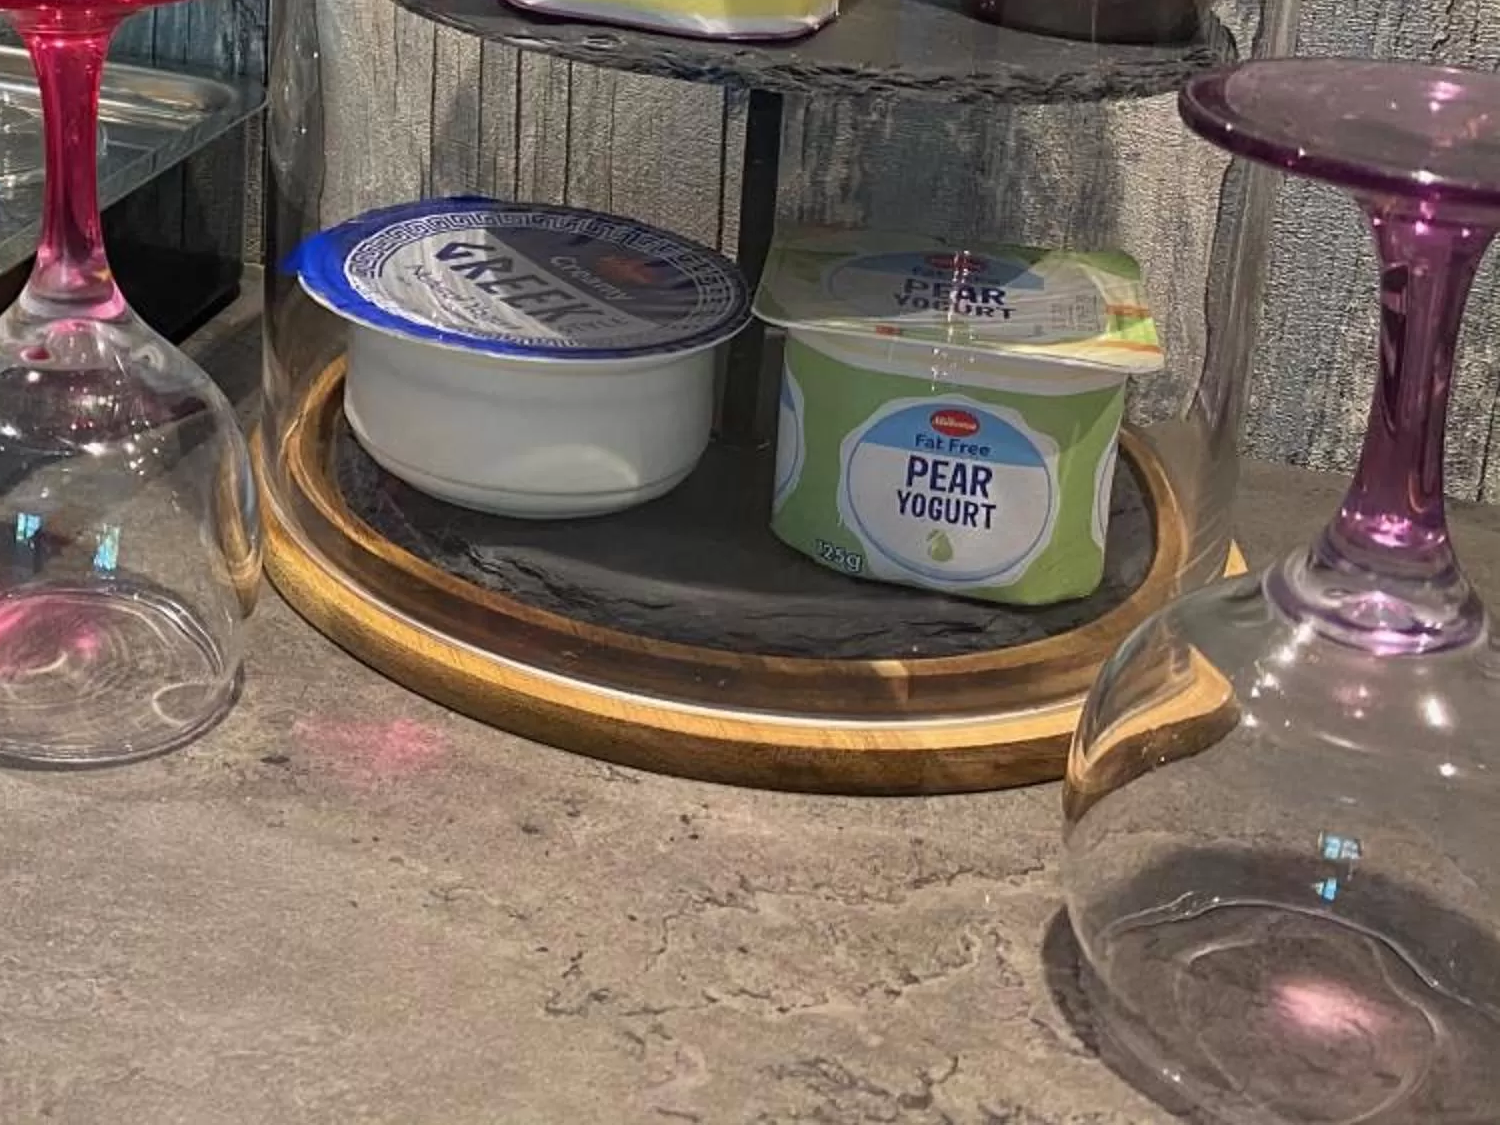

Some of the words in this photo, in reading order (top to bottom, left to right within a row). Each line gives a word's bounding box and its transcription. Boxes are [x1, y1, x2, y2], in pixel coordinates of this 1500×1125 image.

[433, 242, 605, 323] GREEK
[903, 278, 1006, 306] PEAR
[894, 292, 1018, 320] YOGURT
[915, 434, 945, 450] Fat
[948, 438, 992, 456] Free
[906, 455, 993, 499] PEAR
[897, 489, 997, 530] YOGURT
